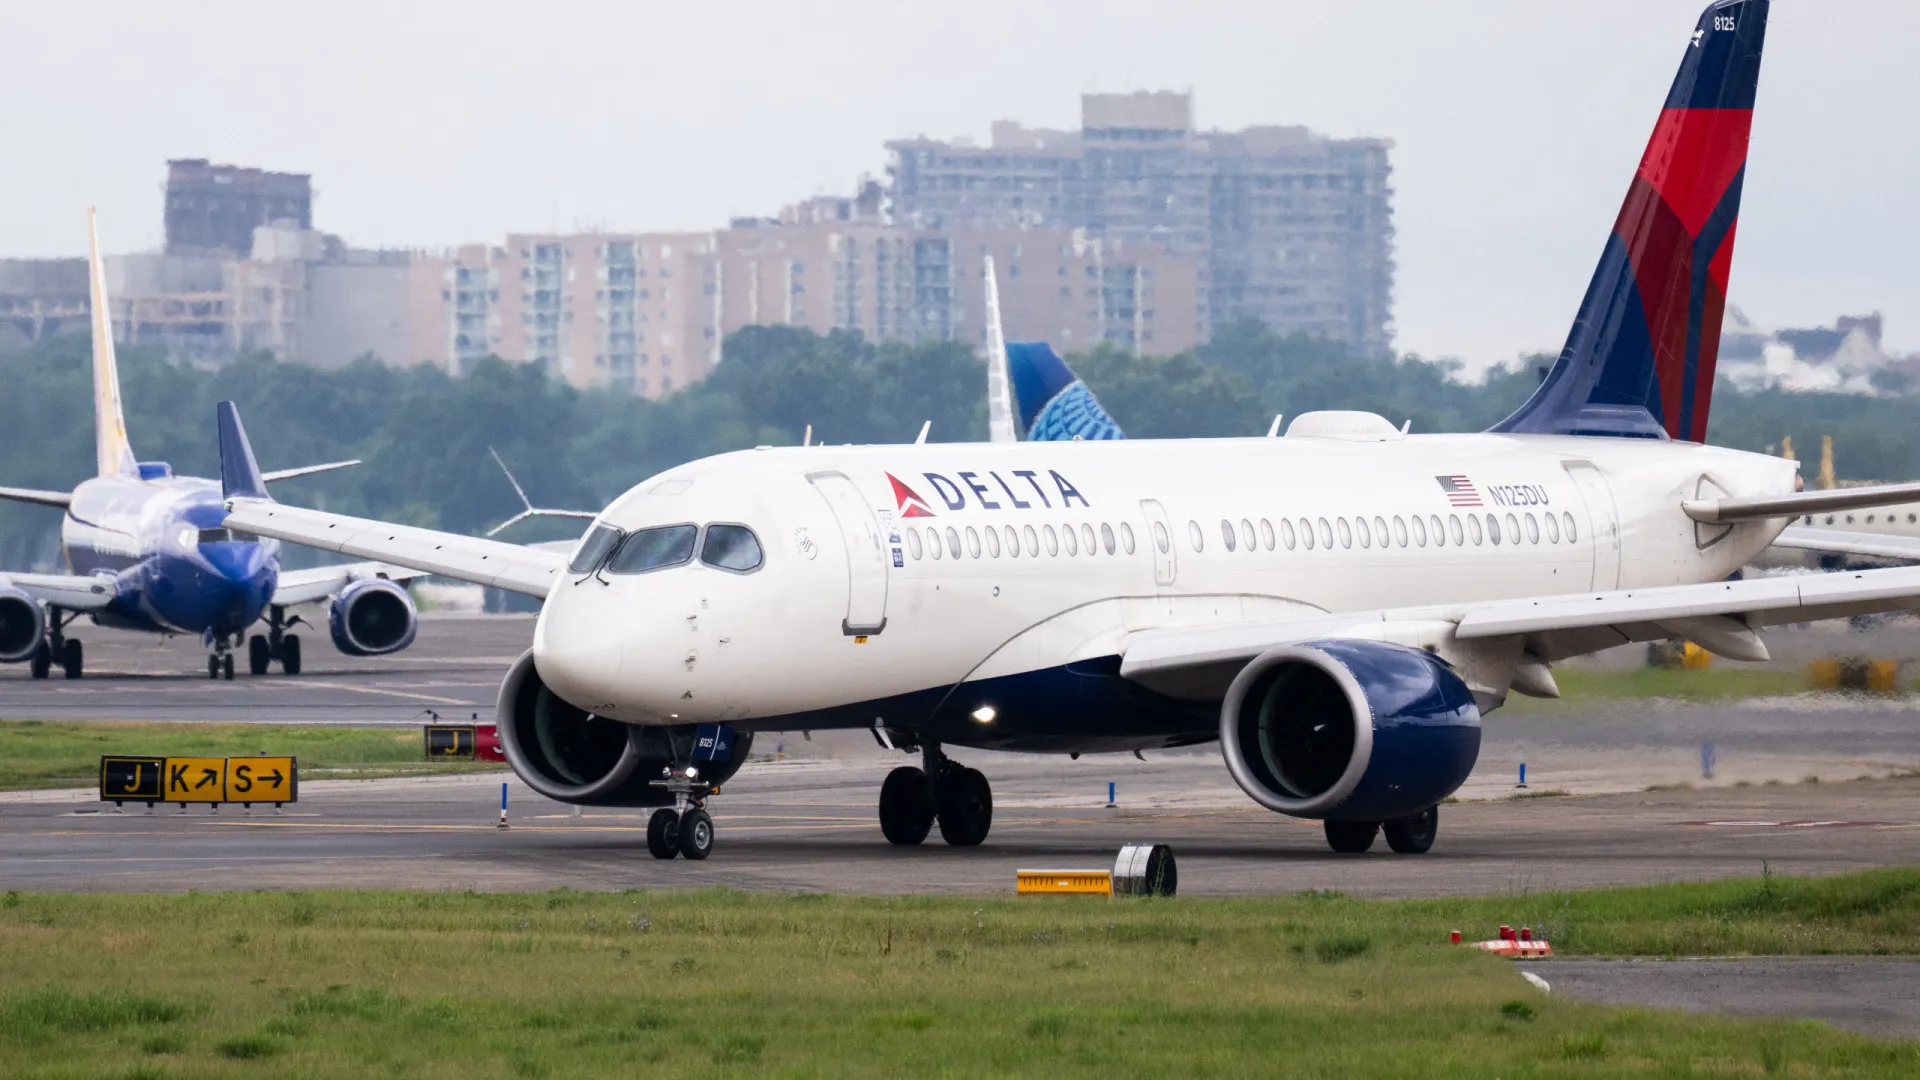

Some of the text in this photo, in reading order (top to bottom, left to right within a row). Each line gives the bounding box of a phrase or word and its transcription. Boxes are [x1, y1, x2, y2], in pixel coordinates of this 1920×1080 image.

[1714, 16, 1735, 31] 8125
[922, 469, 1091, 511] DELTA
[1487, 484, 1549, 507] N125DU
[444, 731, 459, 754] J
[699, 737, 714, 748] 8125
[124, 764, 253, 793] J K S
